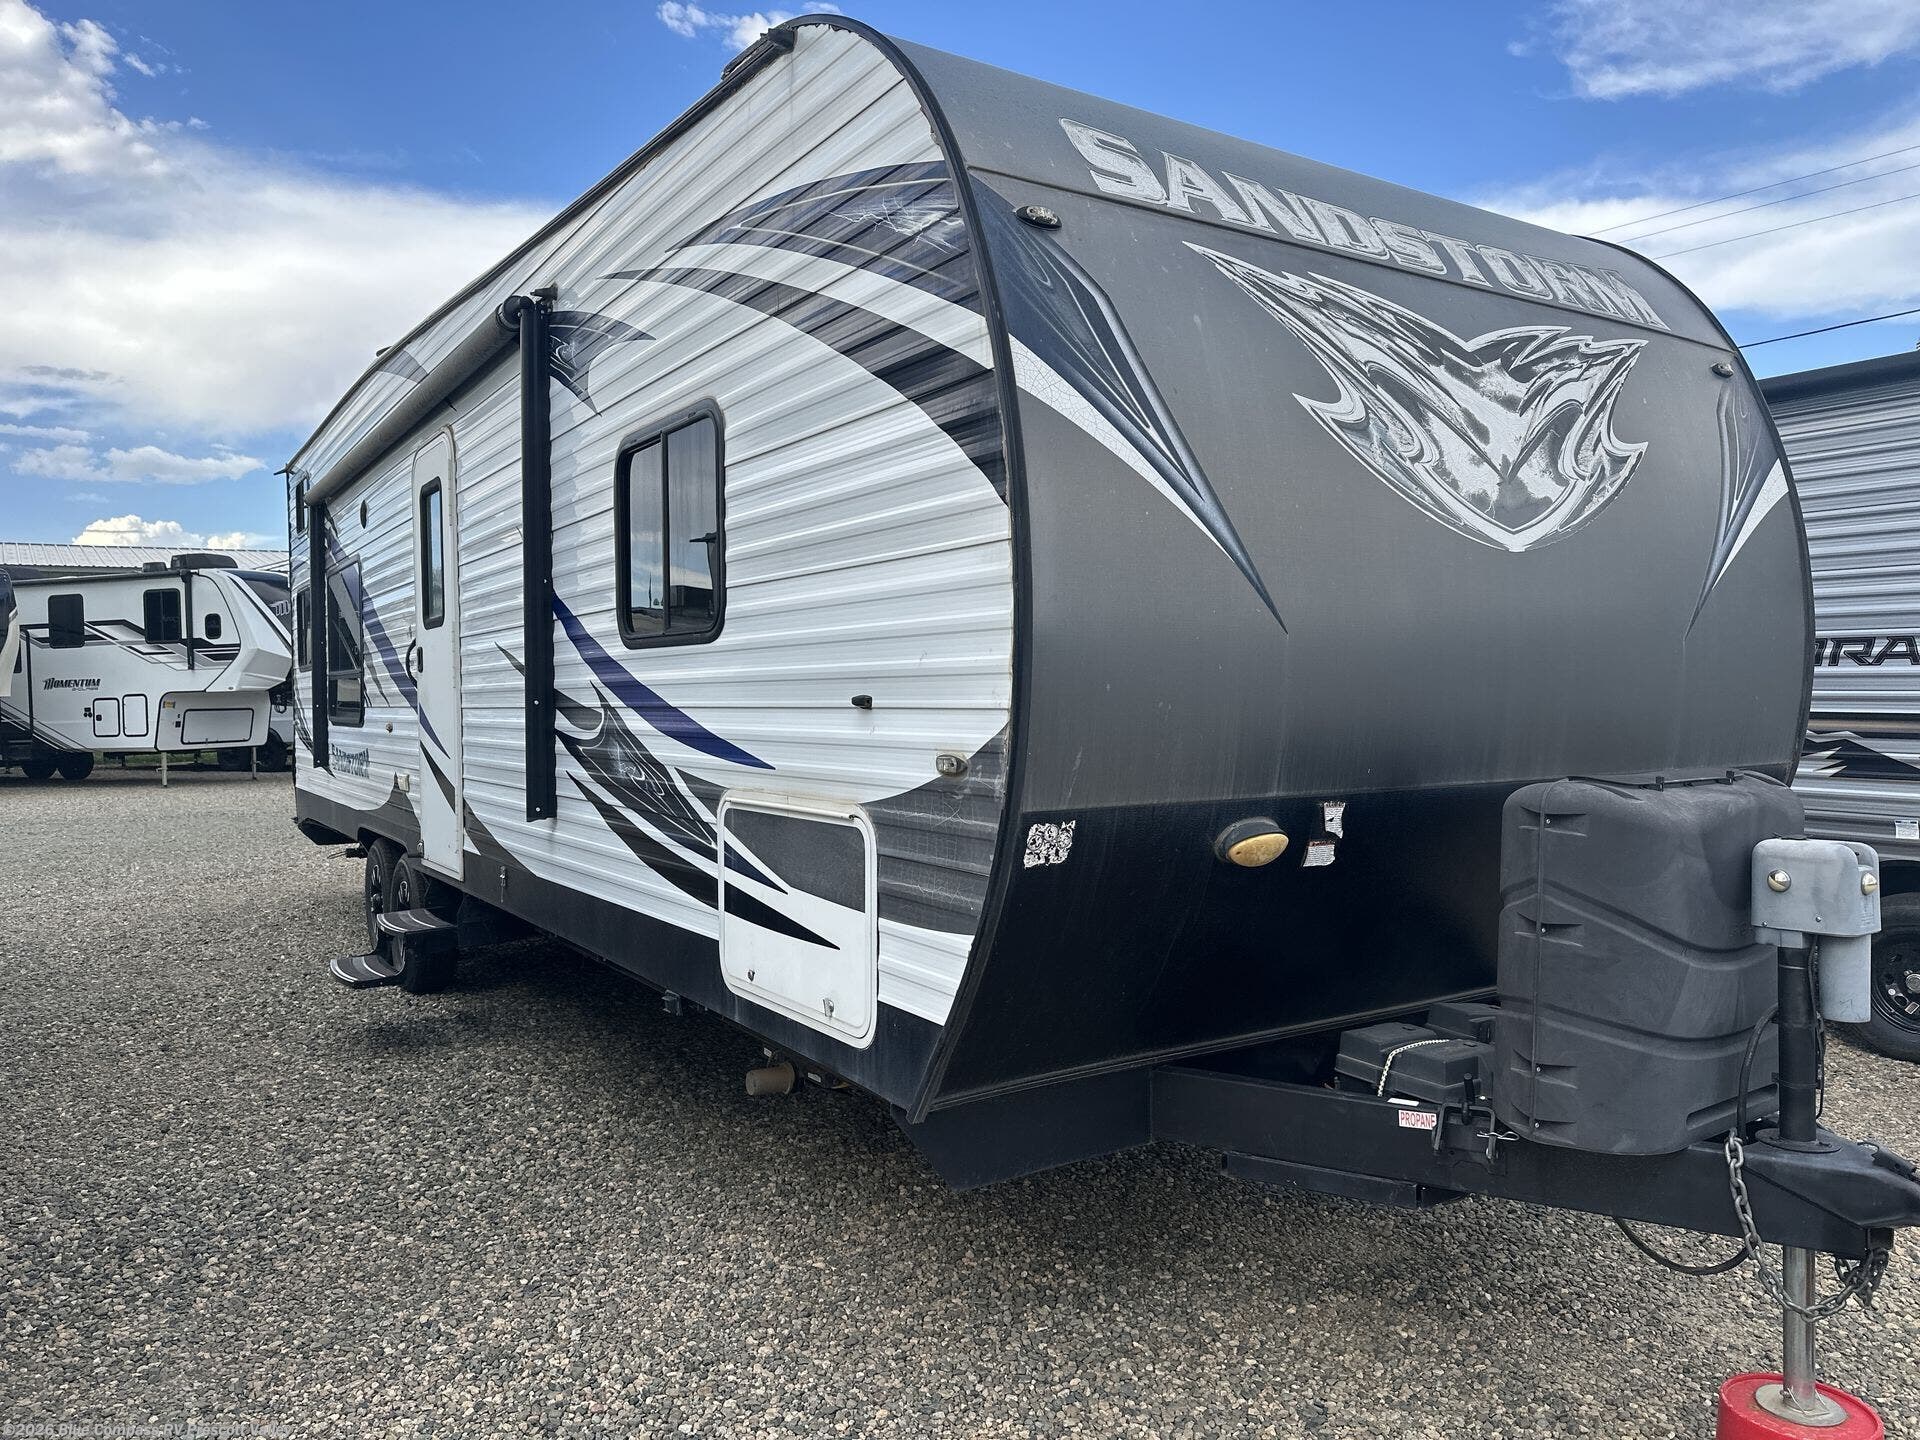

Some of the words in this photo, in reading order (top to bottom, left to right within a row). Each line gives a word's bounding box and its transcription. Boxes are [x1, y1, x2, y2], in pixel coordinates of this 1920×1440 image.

[1059, 117, 1672, 331] SANDSTORM
[43, 677, 101, 690] MOMENTUM
[1401, 1111, 1435, 1129] PROPANE
